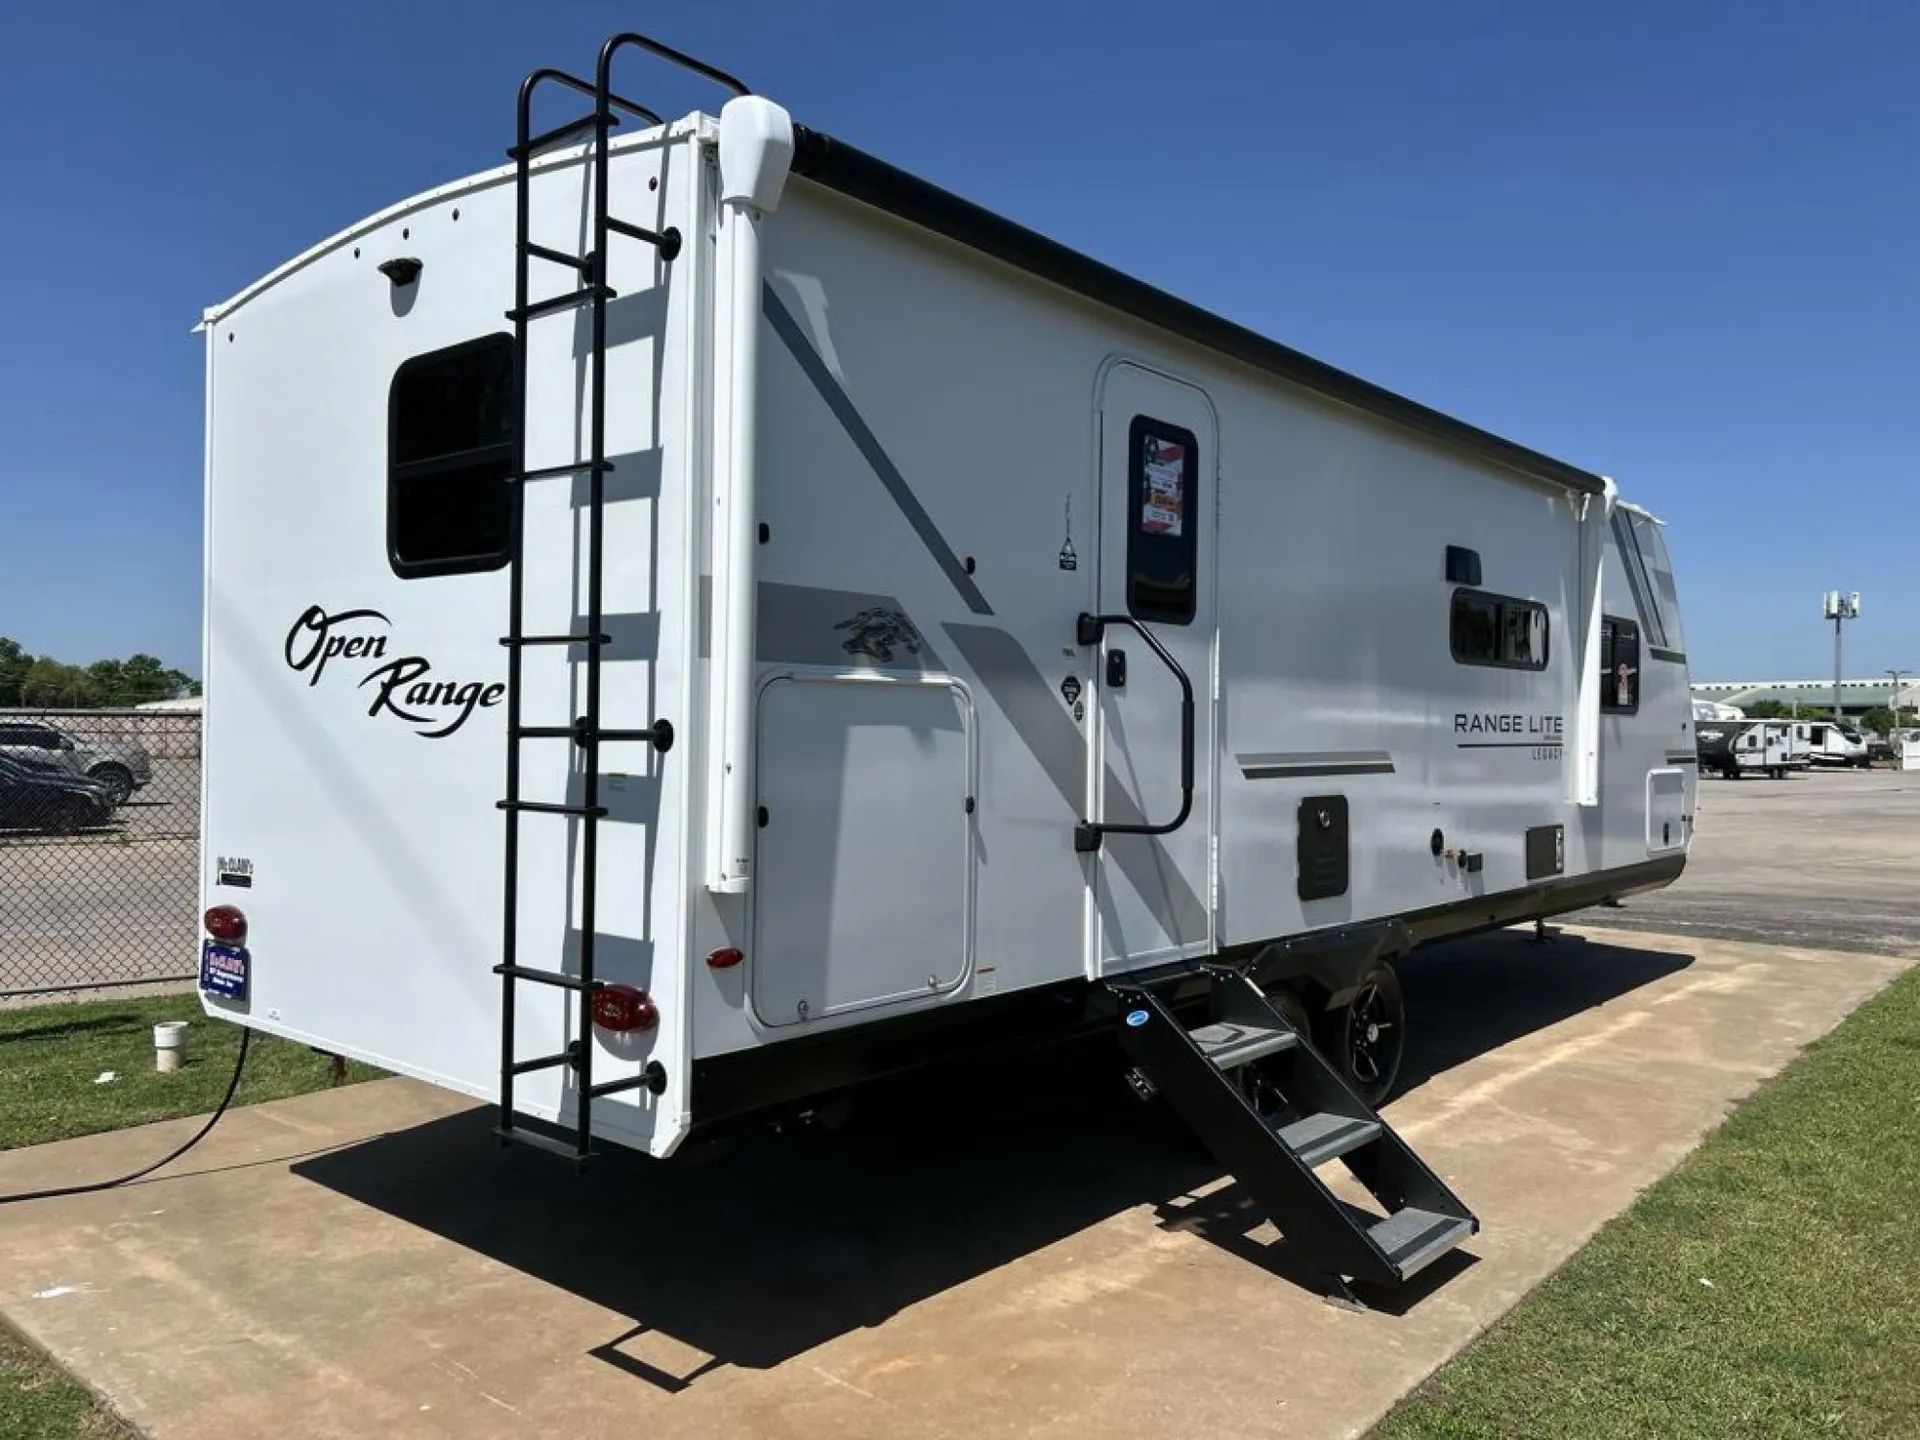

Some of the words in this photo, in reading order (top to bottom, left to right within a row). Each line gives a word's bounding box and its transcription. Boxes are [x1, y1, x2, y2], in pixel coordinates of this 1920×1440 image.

[285, 605, 393, 687] Open
[357, 656, 506, 739] Range
[1454, 713, 1524, 733] RANGE
[1529, 715, 1564, 733] LITE
